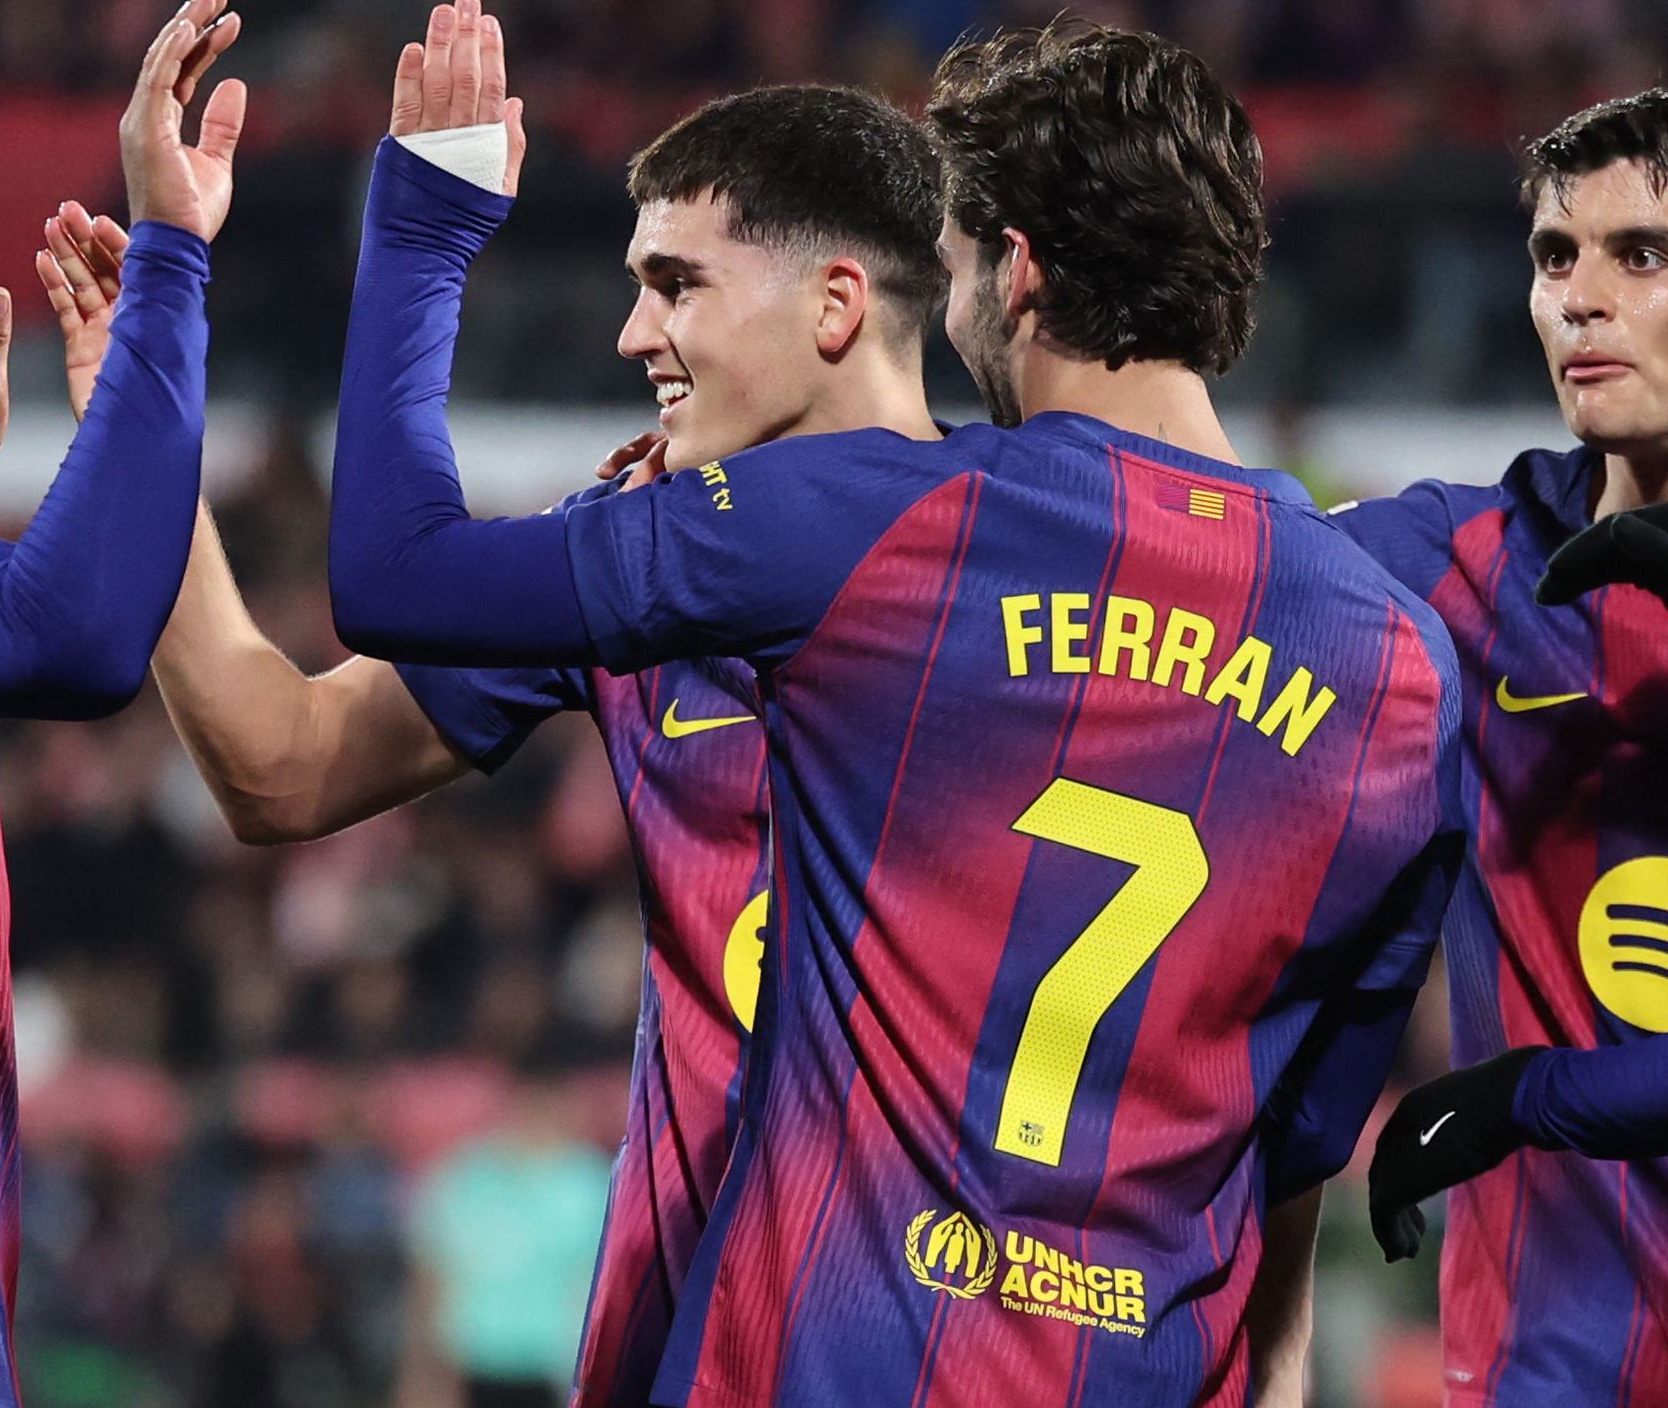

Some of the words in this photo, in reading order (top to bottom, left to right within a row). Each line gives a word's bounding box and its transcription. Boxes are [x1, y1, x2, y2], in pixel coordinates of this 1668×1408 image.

[713, 488, 733, 510] tv
[1000, 592, 1337, 758] FERRAN
[993, 776, 1209, 1167] 7
[1000, 1264, 1146, 1323] ACNUR
[1005, 1230, 1145, 1296] UNHCR
[1000, 1296, 1022, 1313] The
[1024, 1303, 1045, 1316] UN
[1045, 1307, 1098, 1327] Refugee
[1099, 1318, 1146, 1338] Agency
